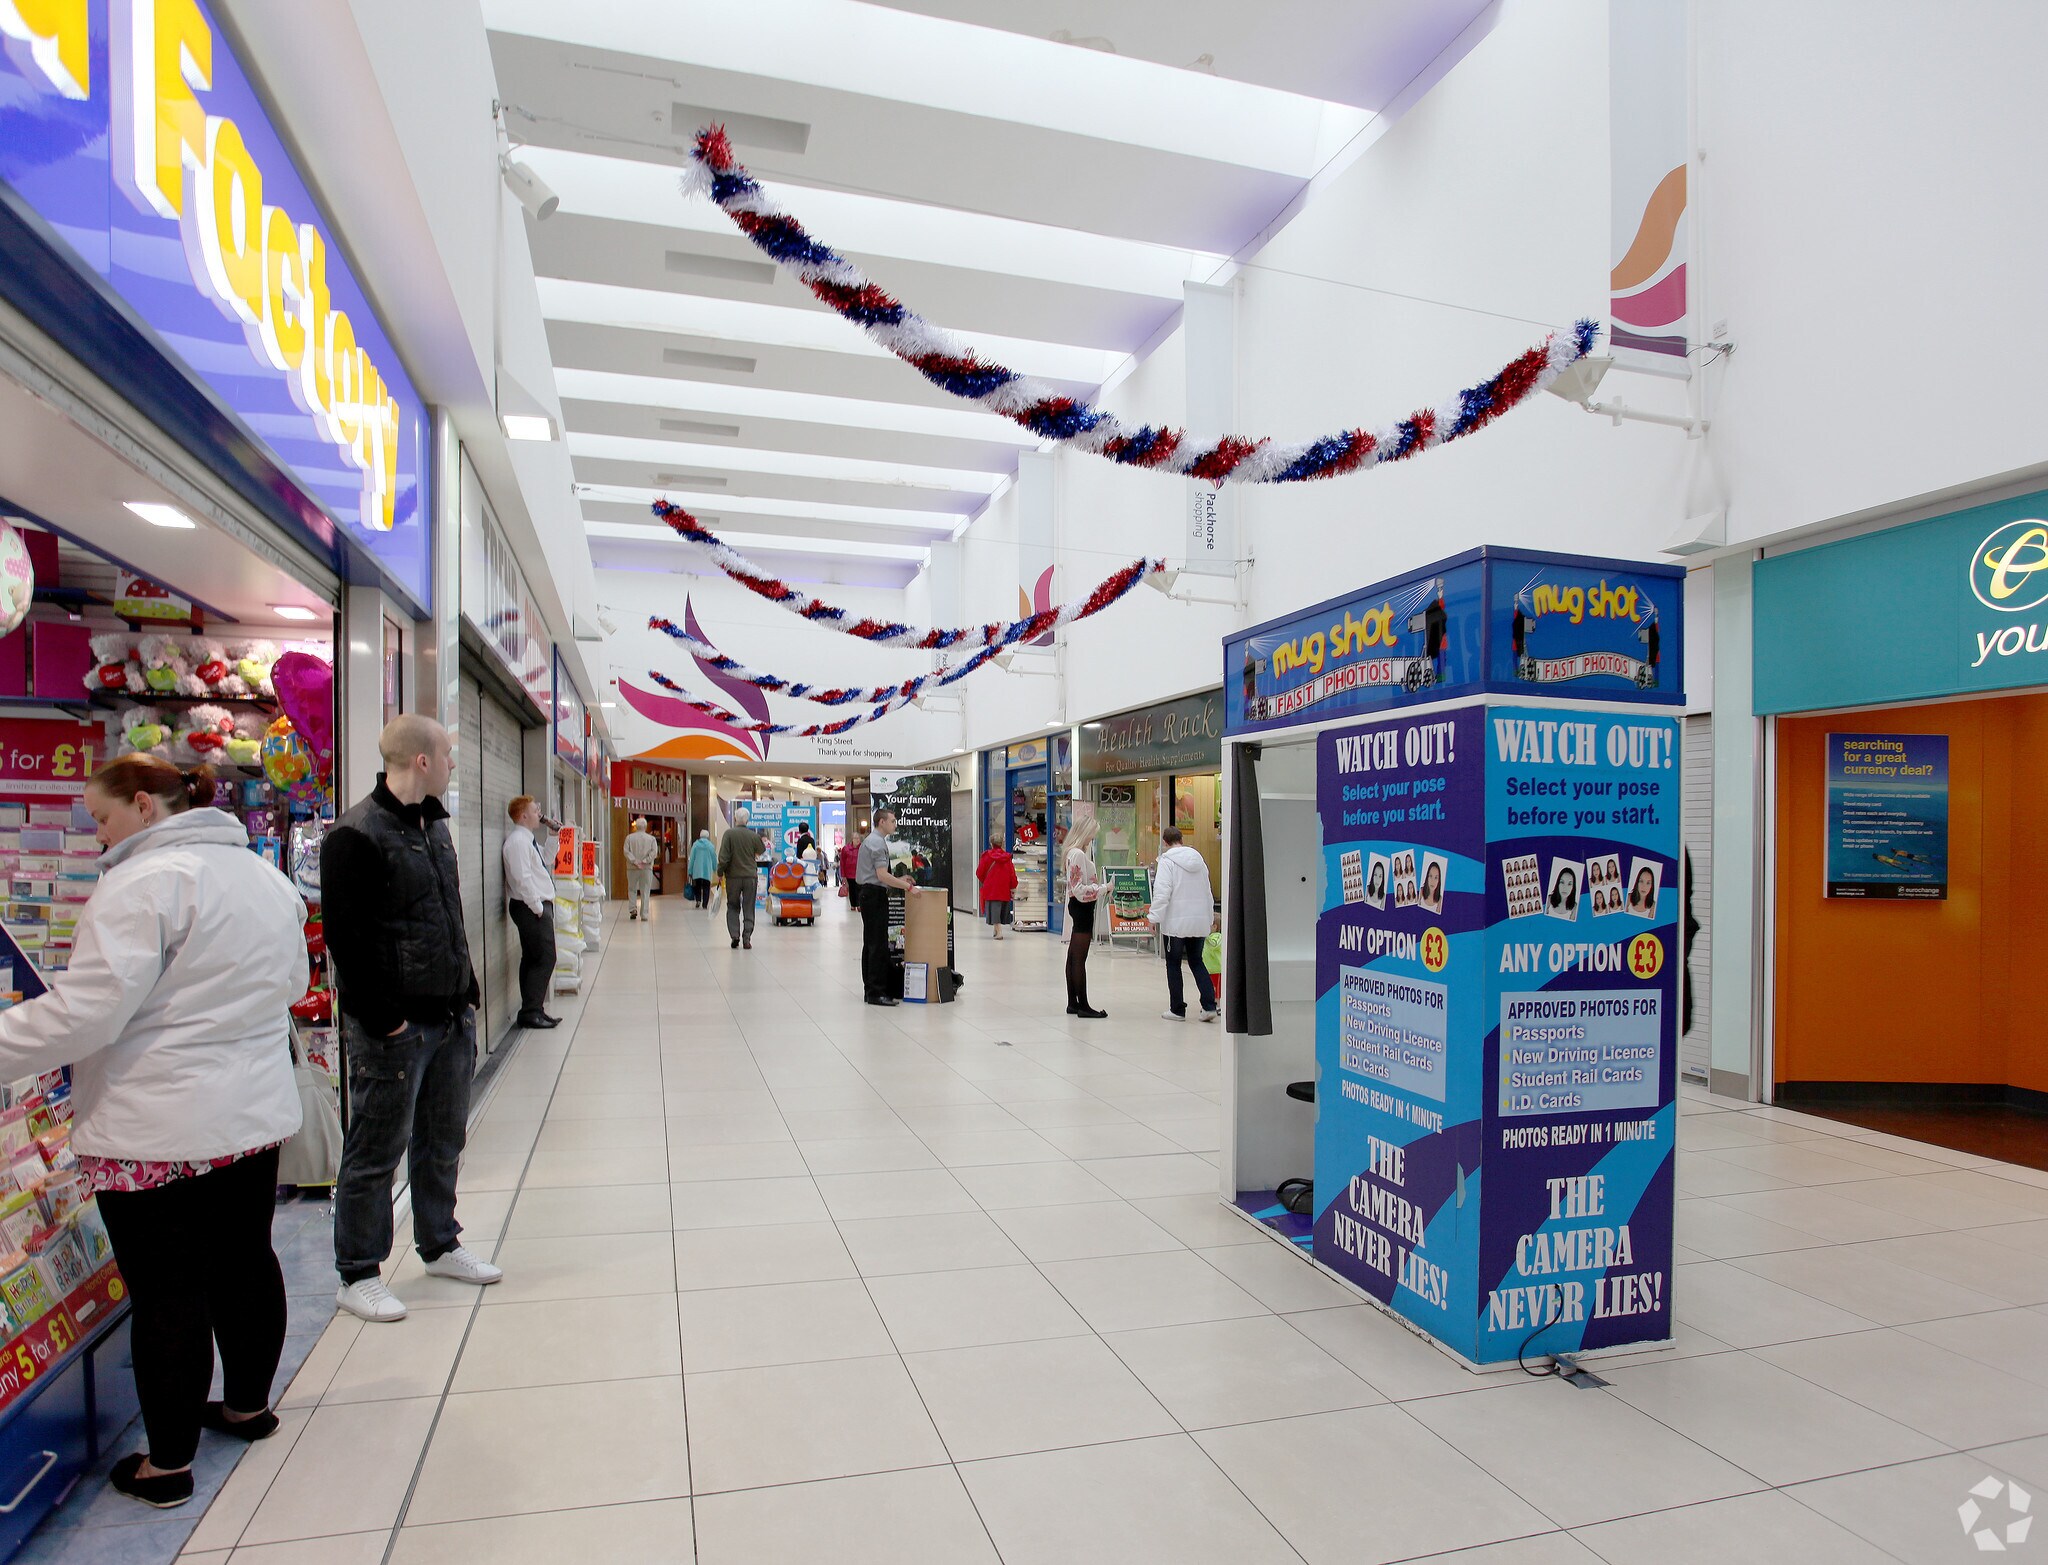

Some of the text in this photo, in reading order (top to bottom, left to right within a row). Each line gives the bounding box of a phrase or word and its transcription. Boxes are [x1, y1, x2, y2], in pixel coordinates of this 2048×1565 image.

[1194, 491, 1203, 538] shopping
[1206, 493, 1216, 550] Packhorse
[1533, 578, 1641, 625] mug shot
[1272, 602, 1398, 679] mug shot
[1544, 655, 1630, 679] FAST PHOTOS
[1276, 662, 1392, 715] FAST PHOTOS
[1097, 698, 1218, 754] Health Rack
[817, 737, 853, 745] King Street
[818, 748, 837, 756] Thank
[852, 749, 861, 757] for
[864, 749, 893, 759] shopping
[1336, 721, 1455, 774] WATCH OUT!
[1494, 719, 1673, 769] WATCH OUT!
[1843, 740, 1904, 752] searching
[10, 744, 94, 777] for £1
[1105, 750, 1205, 773] For Quality Health Supplements
[1843, 752, 1907, 764] for a great
[1843, 765, 1933, 777] currency deal?
[885, 794, 937, 807] Your family
[1342, 776, 1445, 802] Select your pose
[1506, 777, 1660, 800] Select your pose
[896, 817, 948, 827] dland Trust
[901, 808, 922, 816] your
[1343, 801, 1445, 827] before you start.
[1507, 803, 1660, 828] before you start.
[1023, 827, 1033, 838] £5
[1339, 925, 1444, 968] ANY OPTION £3
[1499, 940, 1658, 974] ANY OPTION £3
[1344, 974, 1444, 1010] APPROVED PHOTOS FOR
[1346, 995, 1392, 1018] Passports
[1508, 998, 1657, 1020] APPROVED PHOTOS FOR
[1346, 1014, 1443, 1052] New Driving Licence
[1512, 1025, 1586, 1044] Passports
[1346, 1033, 1433, 1073] Student Rail Cards
[1346, 1053, 1390, 1080] I.D. Cards
[1512, 1046, 1655, 1067] New Driving Licence
[1512, 1066, 1643, 1089] Student Rail Cards
[1341, 1079, 1444, 1135] PHOTOS READY IN 1 MINUTE
[1511, 1091, 1581, 1111] I.D. Cards
[1503, 1120, 1656, 1149] PHOTOS READY IN 1 MINUTE
[1367, 1134, 1405, 1187] THE
[1349, 1175, 1426, 1248] CAMERA
[1546, 1174, 1605, 1220] THE
[1333, 1210, 1448, 1311] NEVER LIES!
[1515, 1225, 1633, 1277] CAMERA
[1488, 1271, 1662, 1332] NEVER LIES!
[15, 1344, 35, 1380] 5
[31, 1338, 51, 1364] for
[47, 1312, 75, 1353] £1
